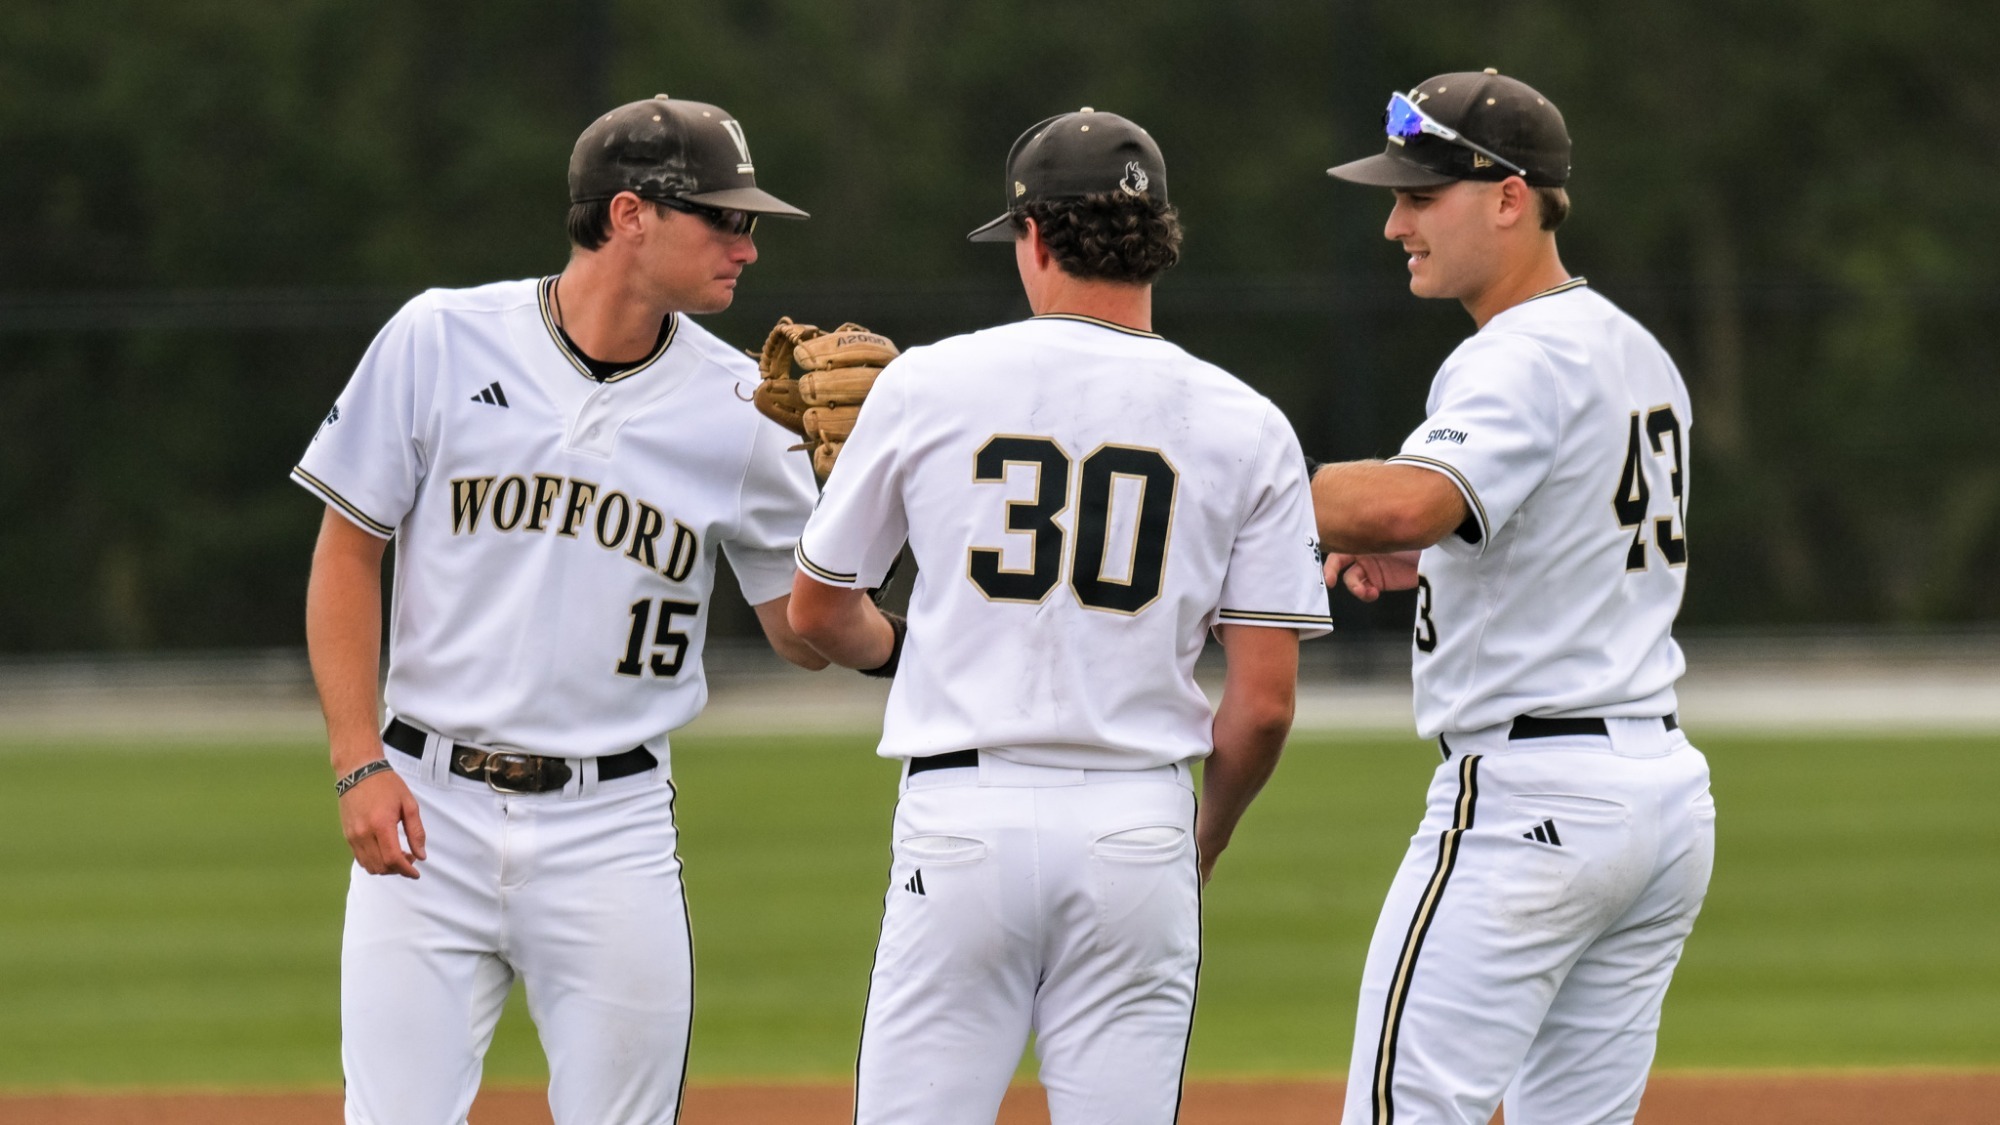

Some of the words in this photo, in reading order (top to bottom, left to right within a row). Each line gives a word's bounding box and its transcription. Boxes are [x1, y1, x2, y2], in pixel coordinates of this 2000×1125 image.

[1425, 428, 1468, 445] SOCON
[1611, 403, 1688, 573] 43
[450, 473, 698, 584] WOFFORD
[966, 433, 1180, 617] 30
[614, 597, 700, 678] 15
